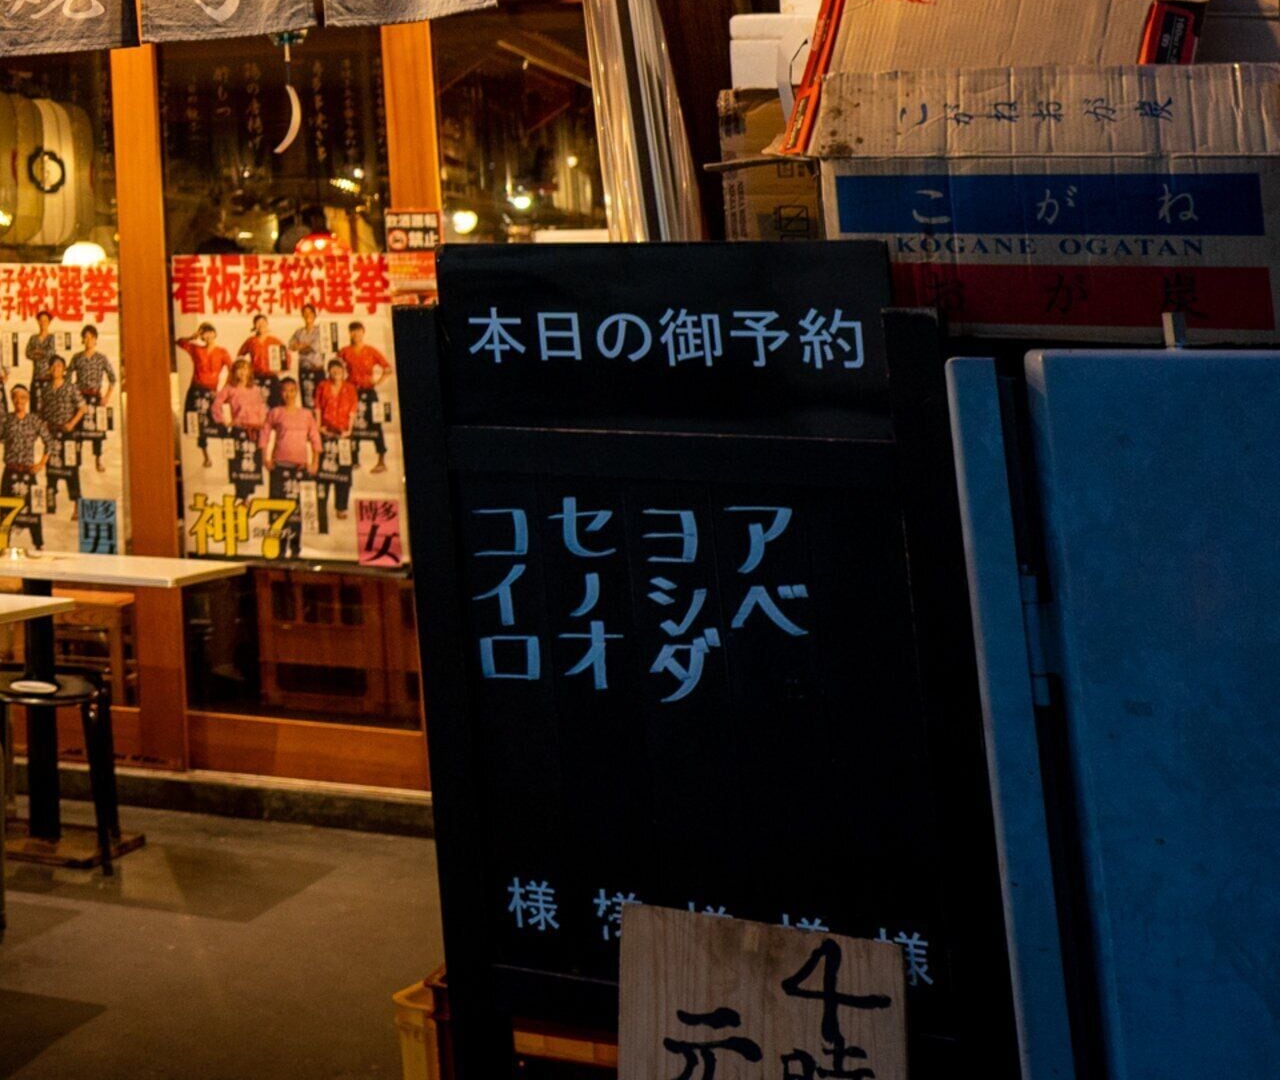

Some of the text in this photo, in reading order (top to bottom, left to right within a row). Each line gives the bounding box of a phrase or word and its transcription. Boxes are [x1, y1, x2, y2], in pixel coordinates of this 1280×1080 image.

[912, 181, 1200, 224] こがね
[896, 236, 1205, 258] KOGANE OGATAN
[173, 254, 242, 314] 看板
[468, 306, 867, 370] 本日の御予約
[364, 523, 401, 564] 女
[722, 505, 810, 637] アベ
[472, 508, 541, 680] コイロ
[547, 496, 625, 691] セノオ
[640, 508, 721, 703] ヨシダ
[506, 876, 560, 932] 様
